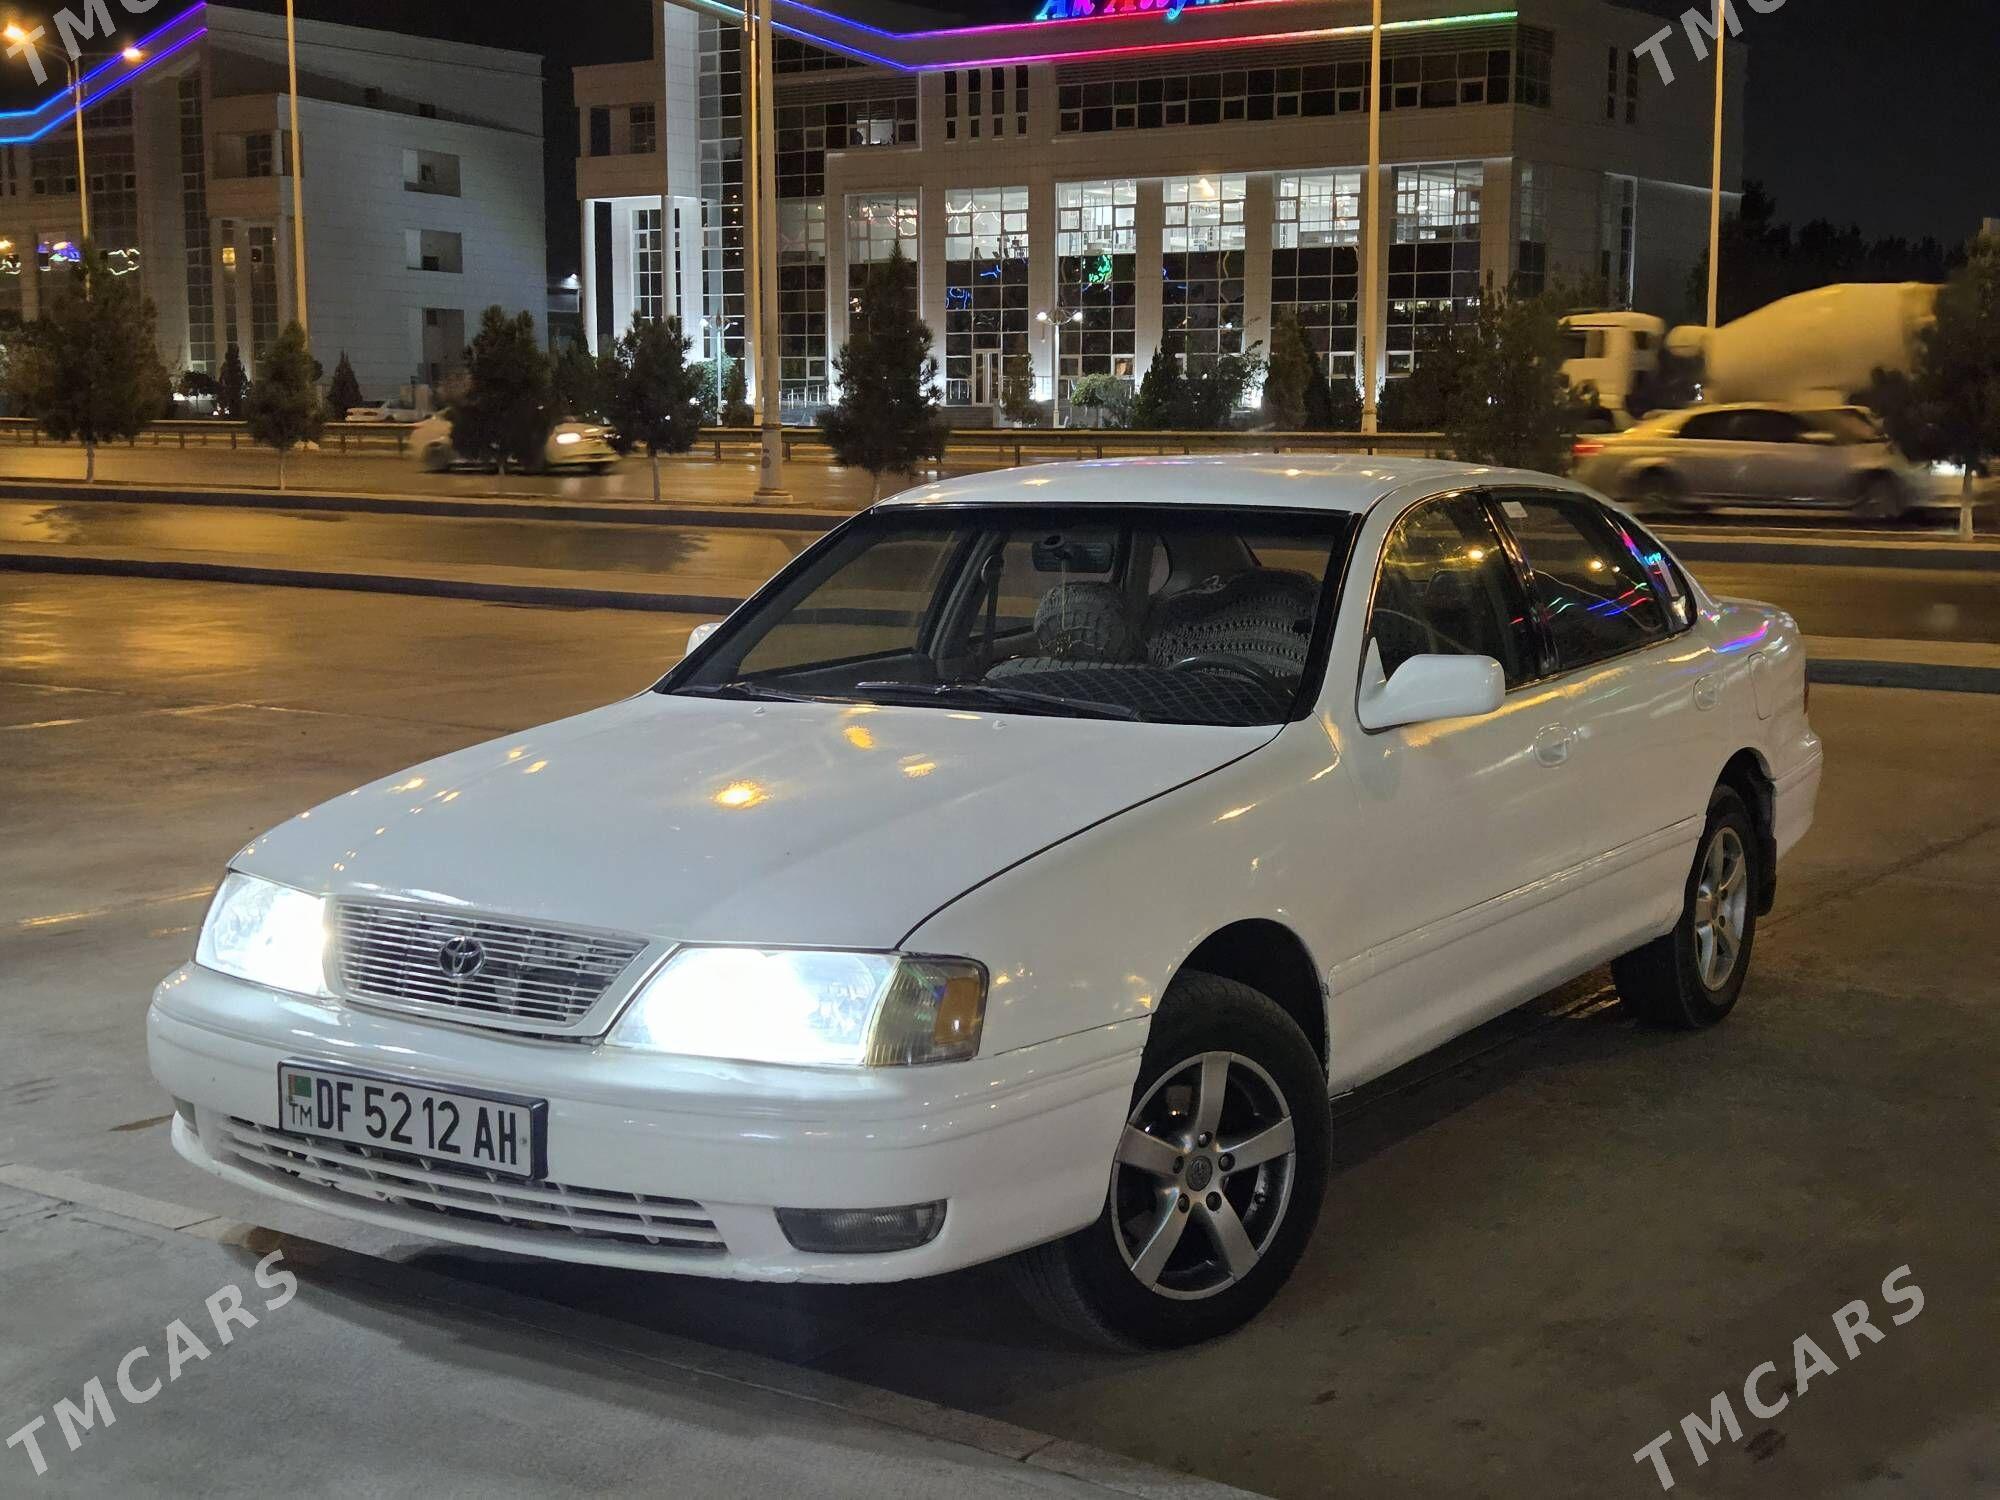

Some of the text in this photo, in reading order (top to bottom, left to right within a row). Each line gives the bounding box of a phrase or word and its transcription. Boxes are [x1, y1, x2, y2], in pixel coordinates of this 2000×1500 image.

[288, 1102, 312, 1128] TM
[316, 1078, 517, 1165] DF 5212 AH
